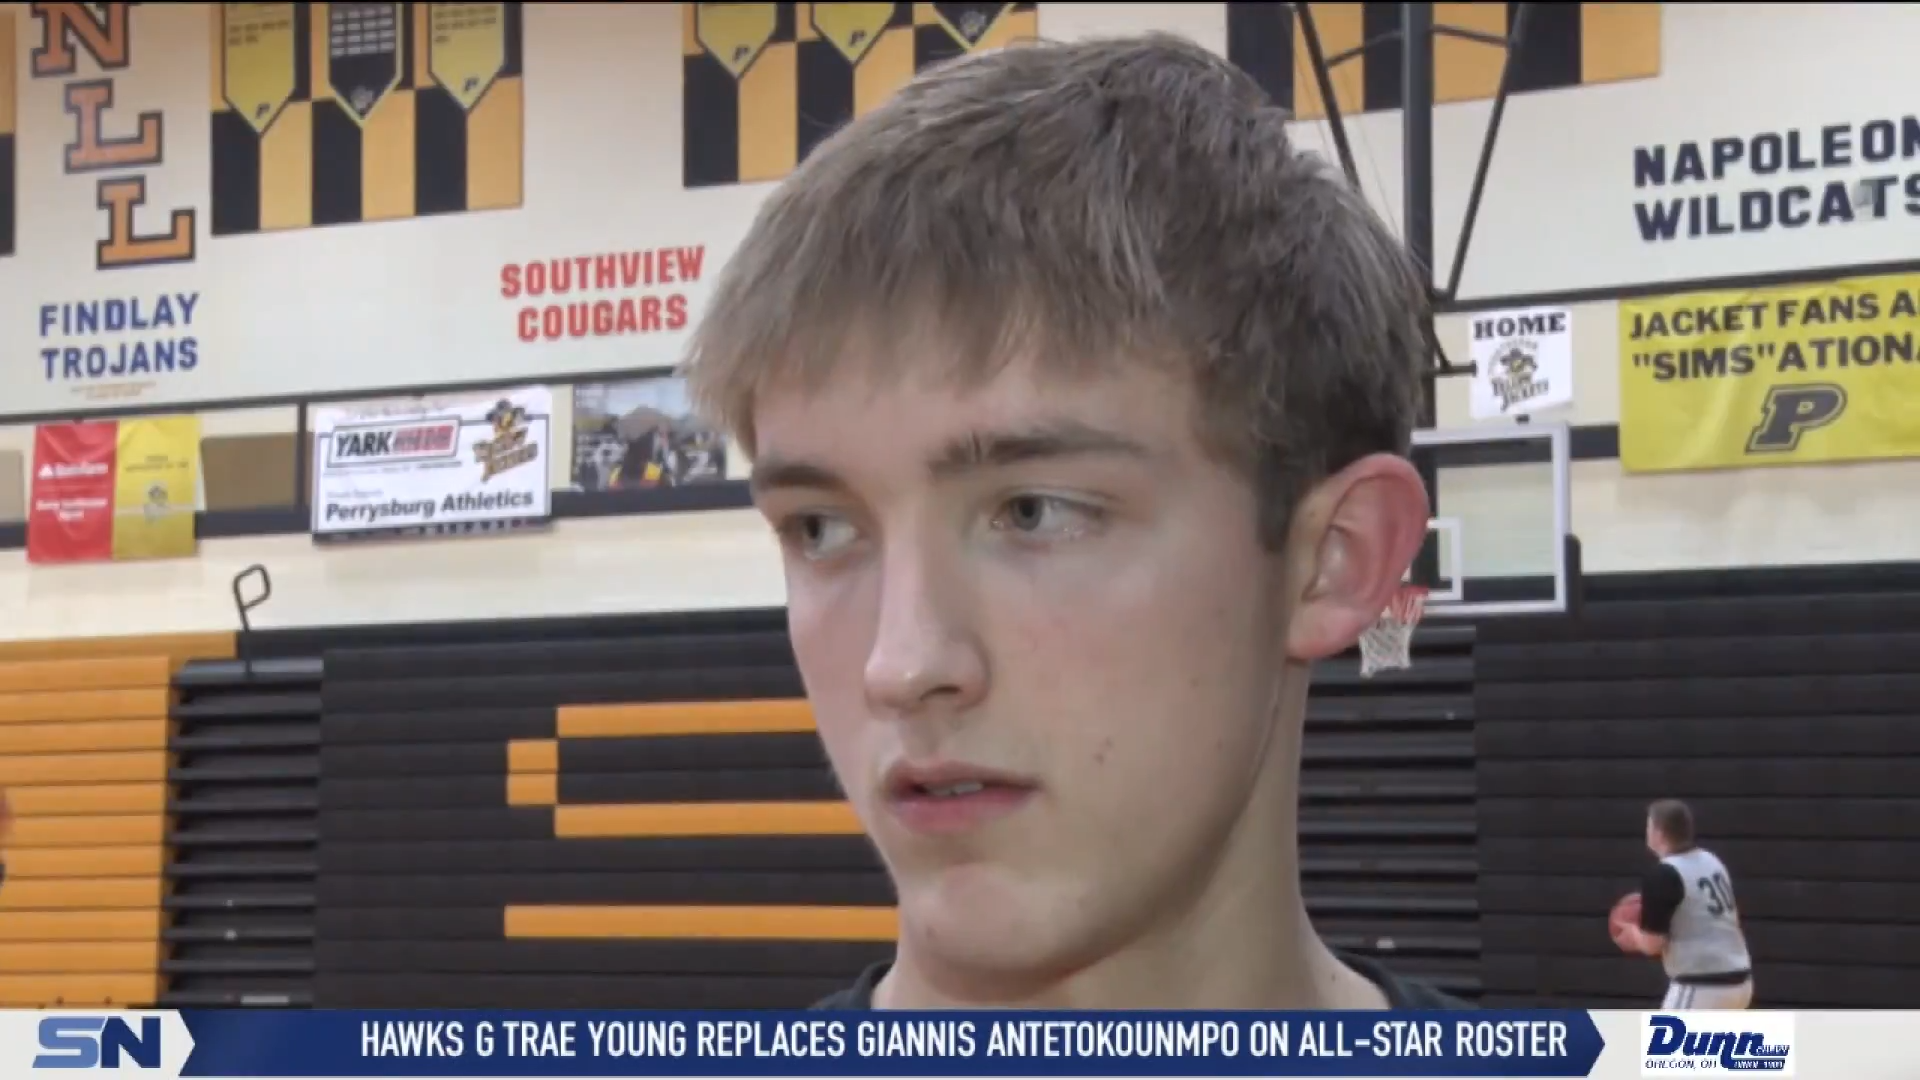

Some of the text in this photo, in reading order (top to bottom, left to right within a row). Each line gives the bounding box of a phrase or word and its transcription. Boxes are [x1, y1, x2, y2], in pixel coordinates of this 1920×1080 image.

[500, 246, 705, 299] SOUTHVIEW
[40, 292, 199, 337] FINDLAY
[517, 294, 688, 343] COUGARS
[1474, 312, 1566, 340] HOME
[1630, 289, 1920, 341] JACKET FANS A
[40, 337, 199, 381] TROJANS
[1632, 331, 1920, 380] "SIMS"ATION
[1745, 384, 1848, 455] P
[336, 431, 392, 457] YARK
[326, 490, 534, 522] Perrysburg Athletics
